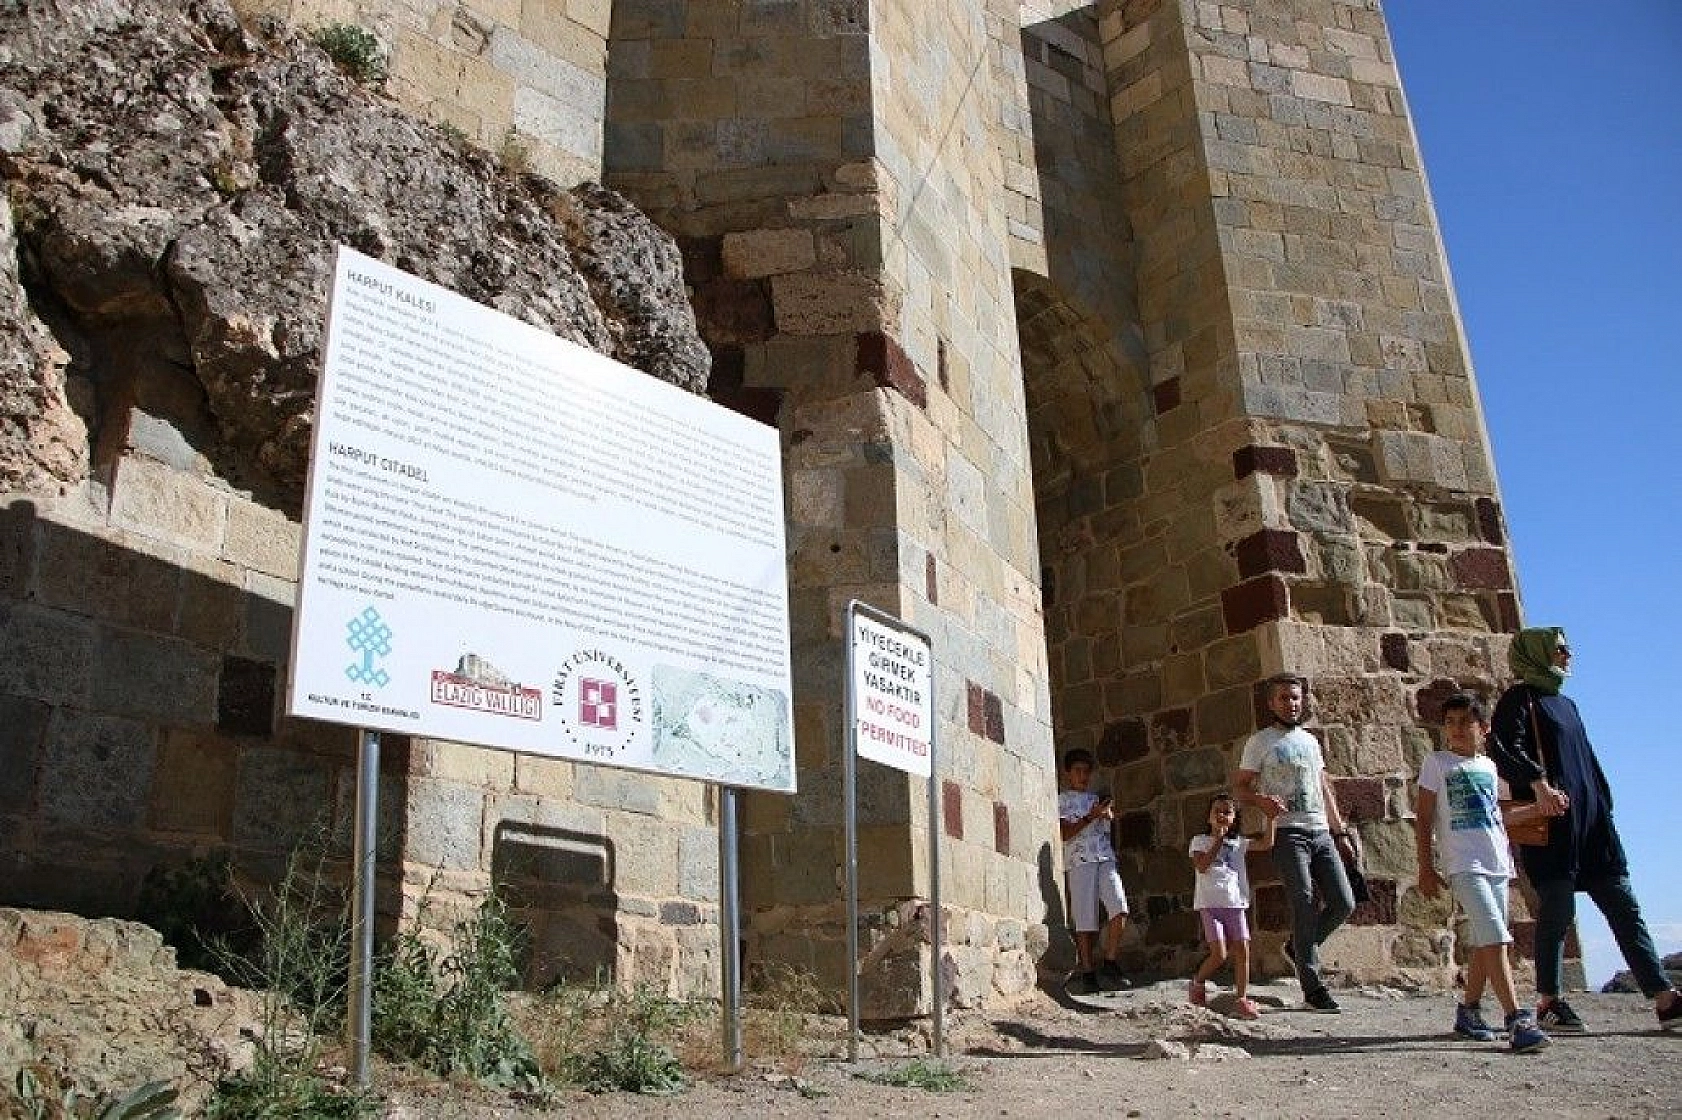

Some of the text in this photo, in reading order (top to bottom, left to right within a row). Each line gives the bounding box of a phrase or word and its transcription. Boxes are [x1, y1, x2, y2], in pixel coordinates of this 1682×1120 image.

[346, 268, 393, 296] HARPUT
[329, 441, 428, 482] HARPUT CITADEL
[863, 670, 922, 706] YASAKTIR
[867, 696, 920, 729] NO FOOD
[861, 721, 927, 757] PERMITTED
